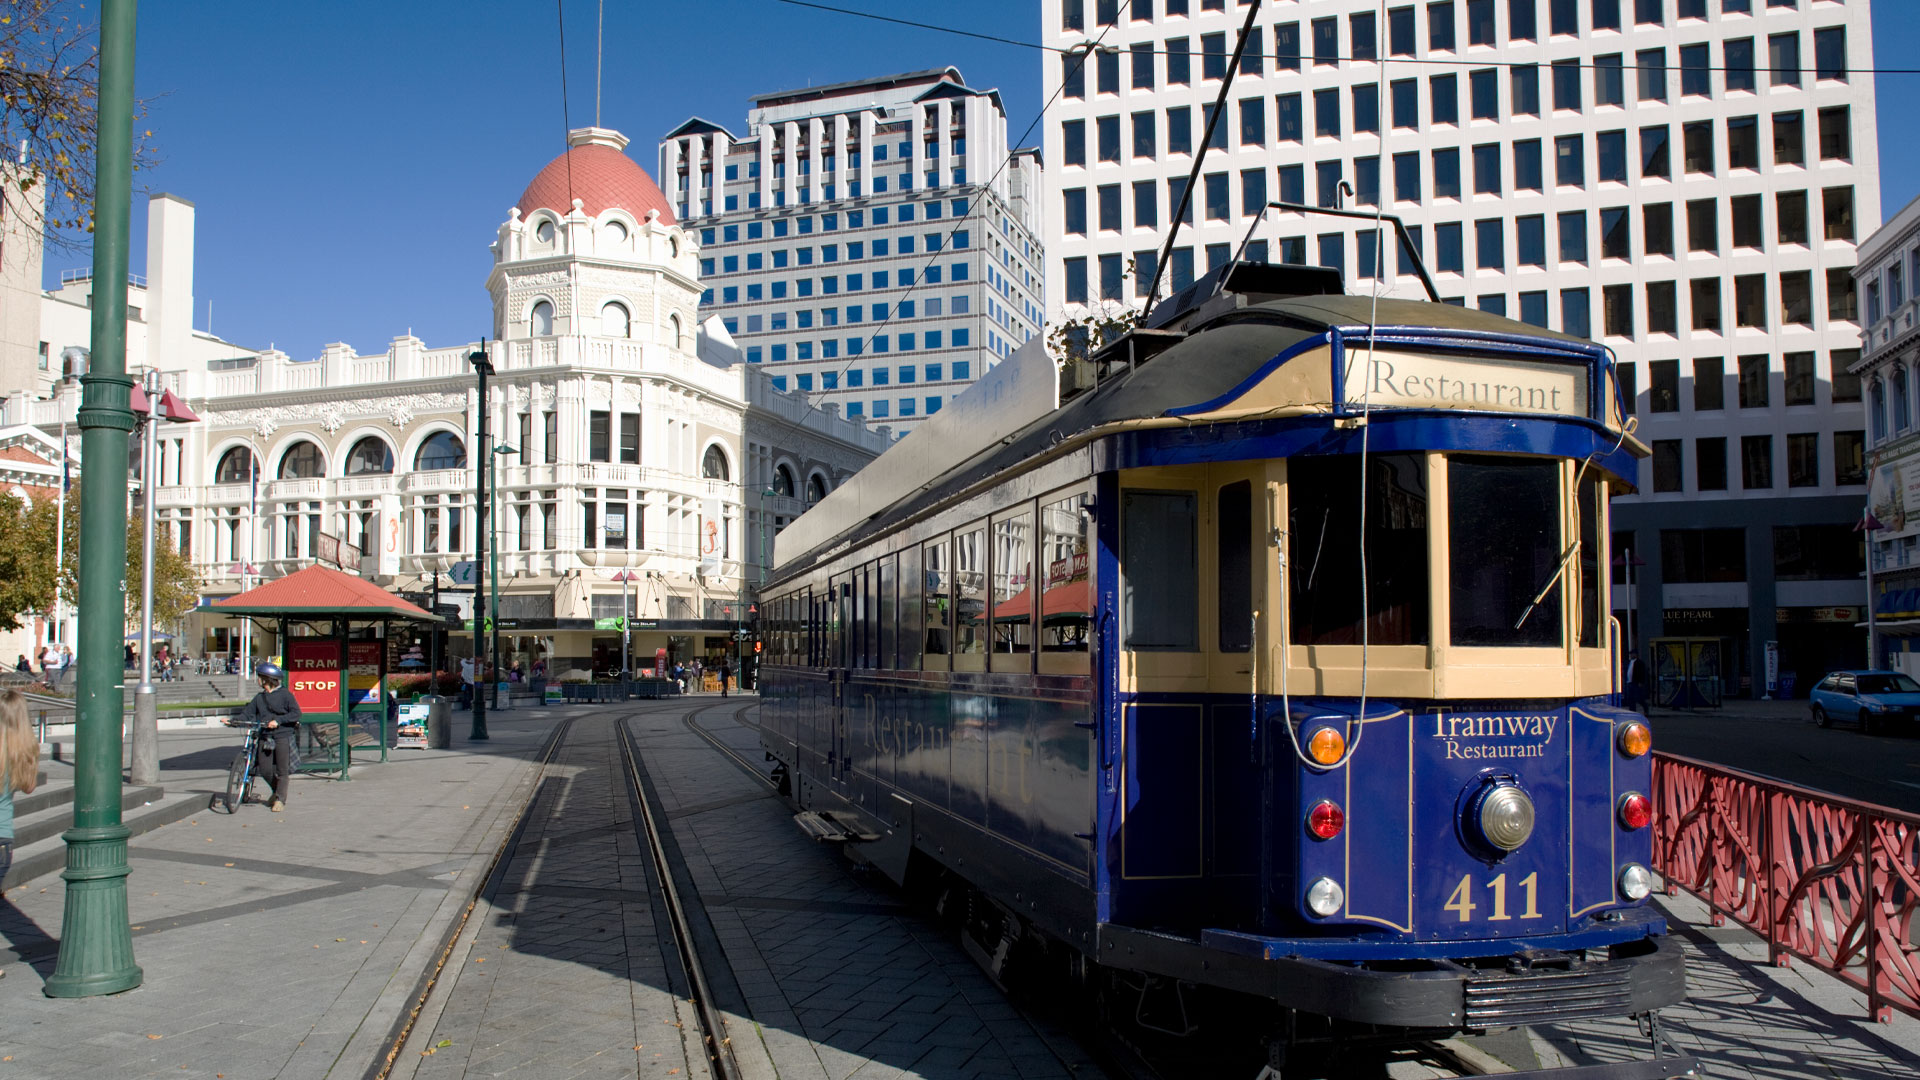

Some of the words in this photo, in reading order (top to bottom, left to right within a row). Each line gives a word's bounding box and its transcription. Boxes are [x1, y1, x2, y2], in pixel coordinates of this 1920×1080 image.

[1371, 360, 1561, 412] Restaurant
[1662, 610, 1681, 619] LUE
[1683, 610, 1714, 619] PEARL
[294, 658, 337, 668] TRAM
[293, 681, 337, 691] STOP
[1426, 705, 1559, 745] Tramway
[1445, 741, 1545, 760] Restaurant
[1443, 871, 1543, 923] 411
